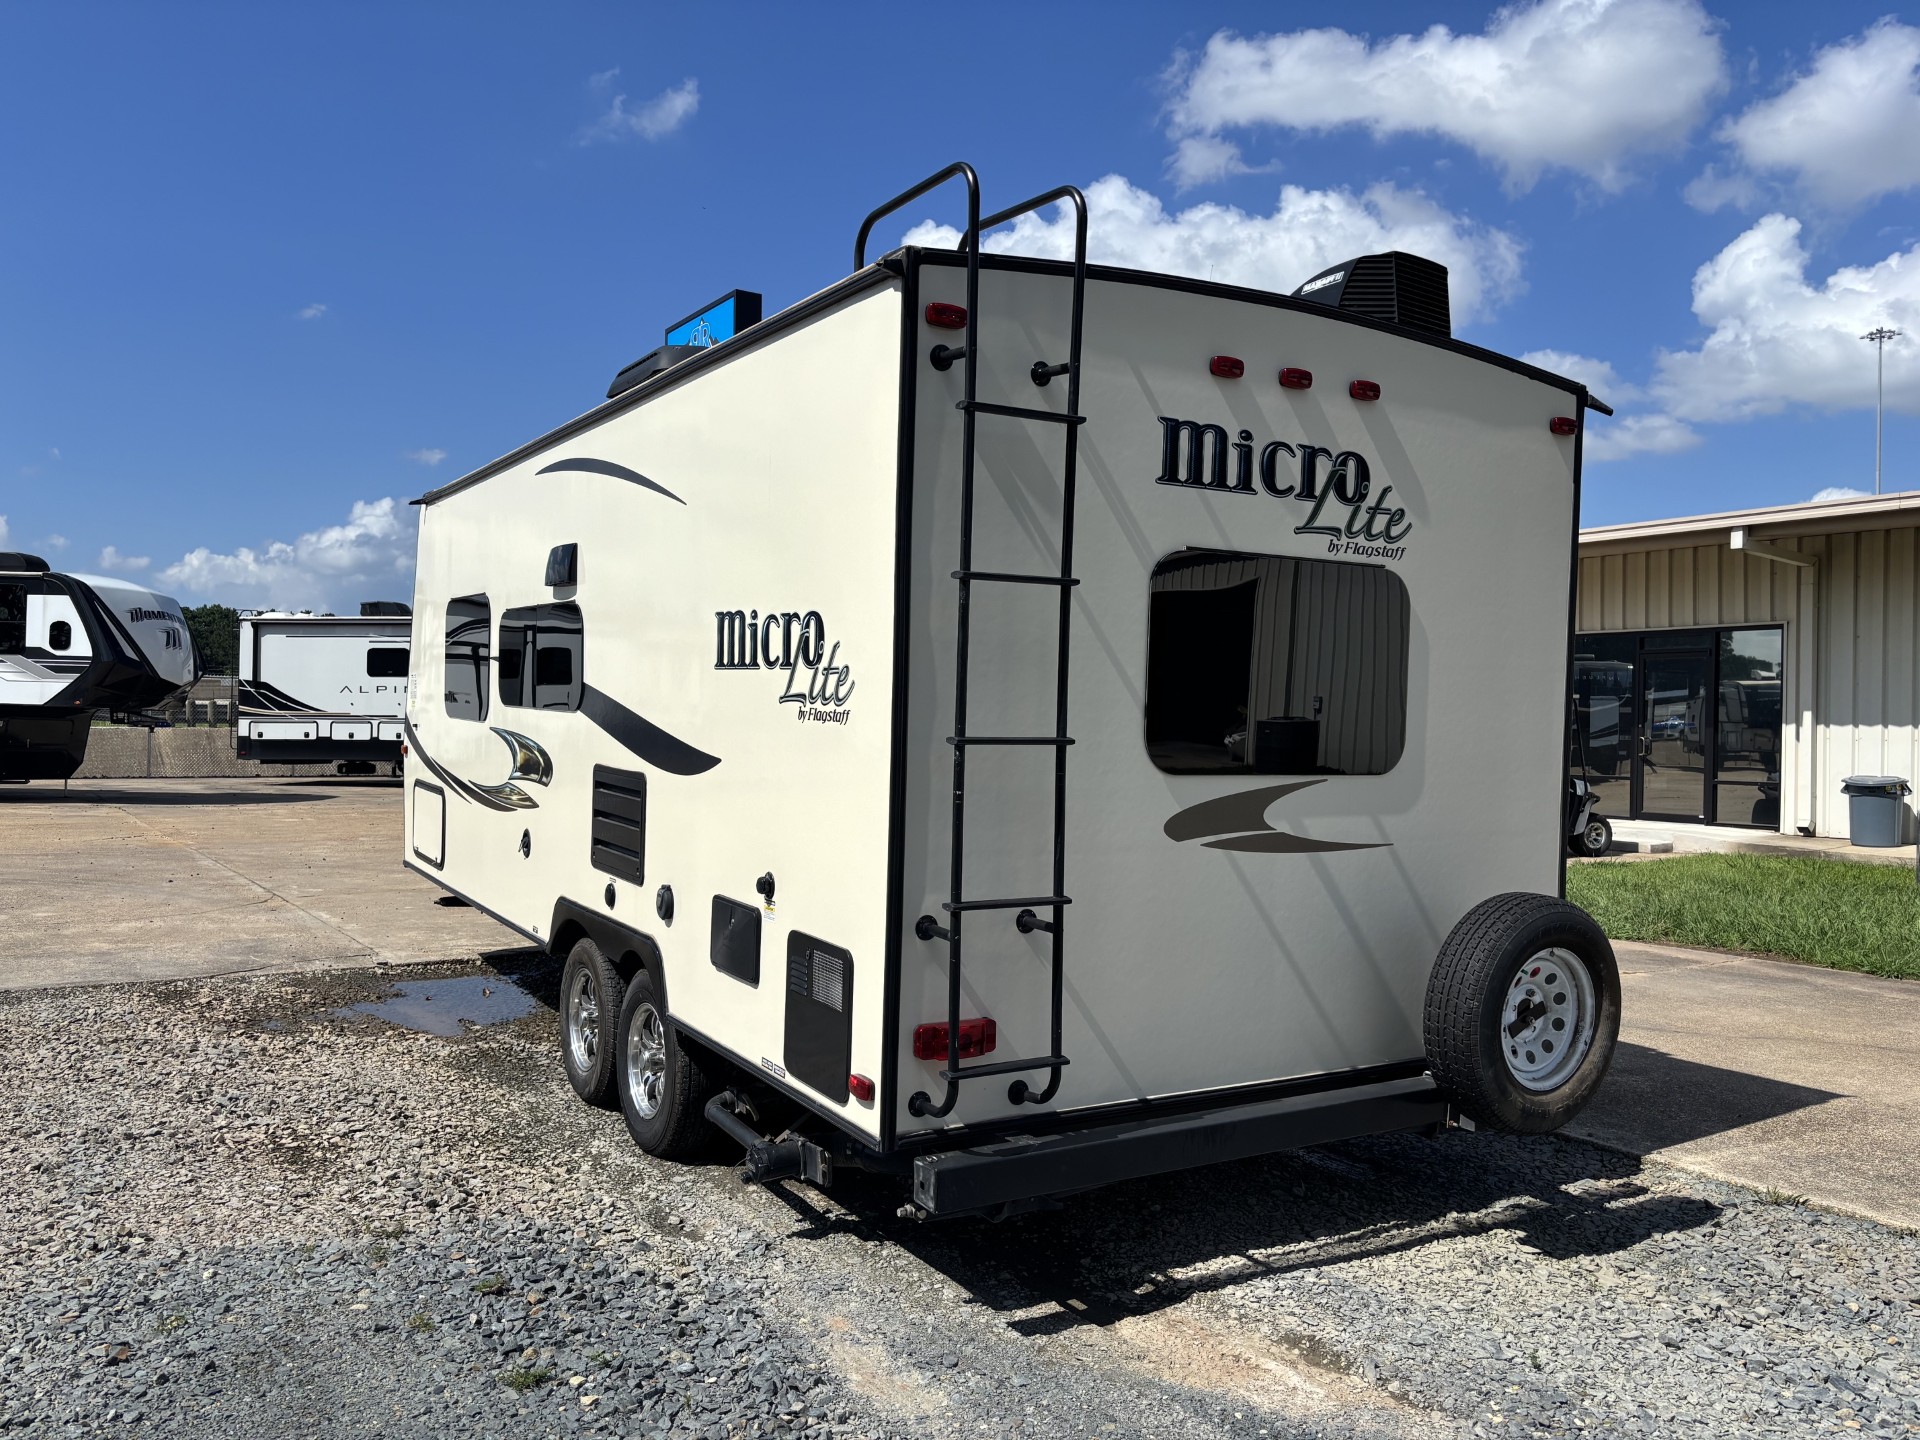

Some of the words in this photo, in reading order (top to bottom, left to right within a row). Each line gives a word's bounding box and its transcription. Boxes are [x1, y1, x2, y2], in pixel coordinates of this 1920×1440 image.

[1155, 415, 1371, 506] micro
[1293, 467, 1412, 544] Lite
[1327, 539, 1343, 557] by
[1343, 541, 1407, 561] Flagstaff
[714, 609, 825, 670] micro
[778, 628, 855, 708] Lite
[798, 707, 808, 723] by
[808, 708, 850, 725] Flagstaff
